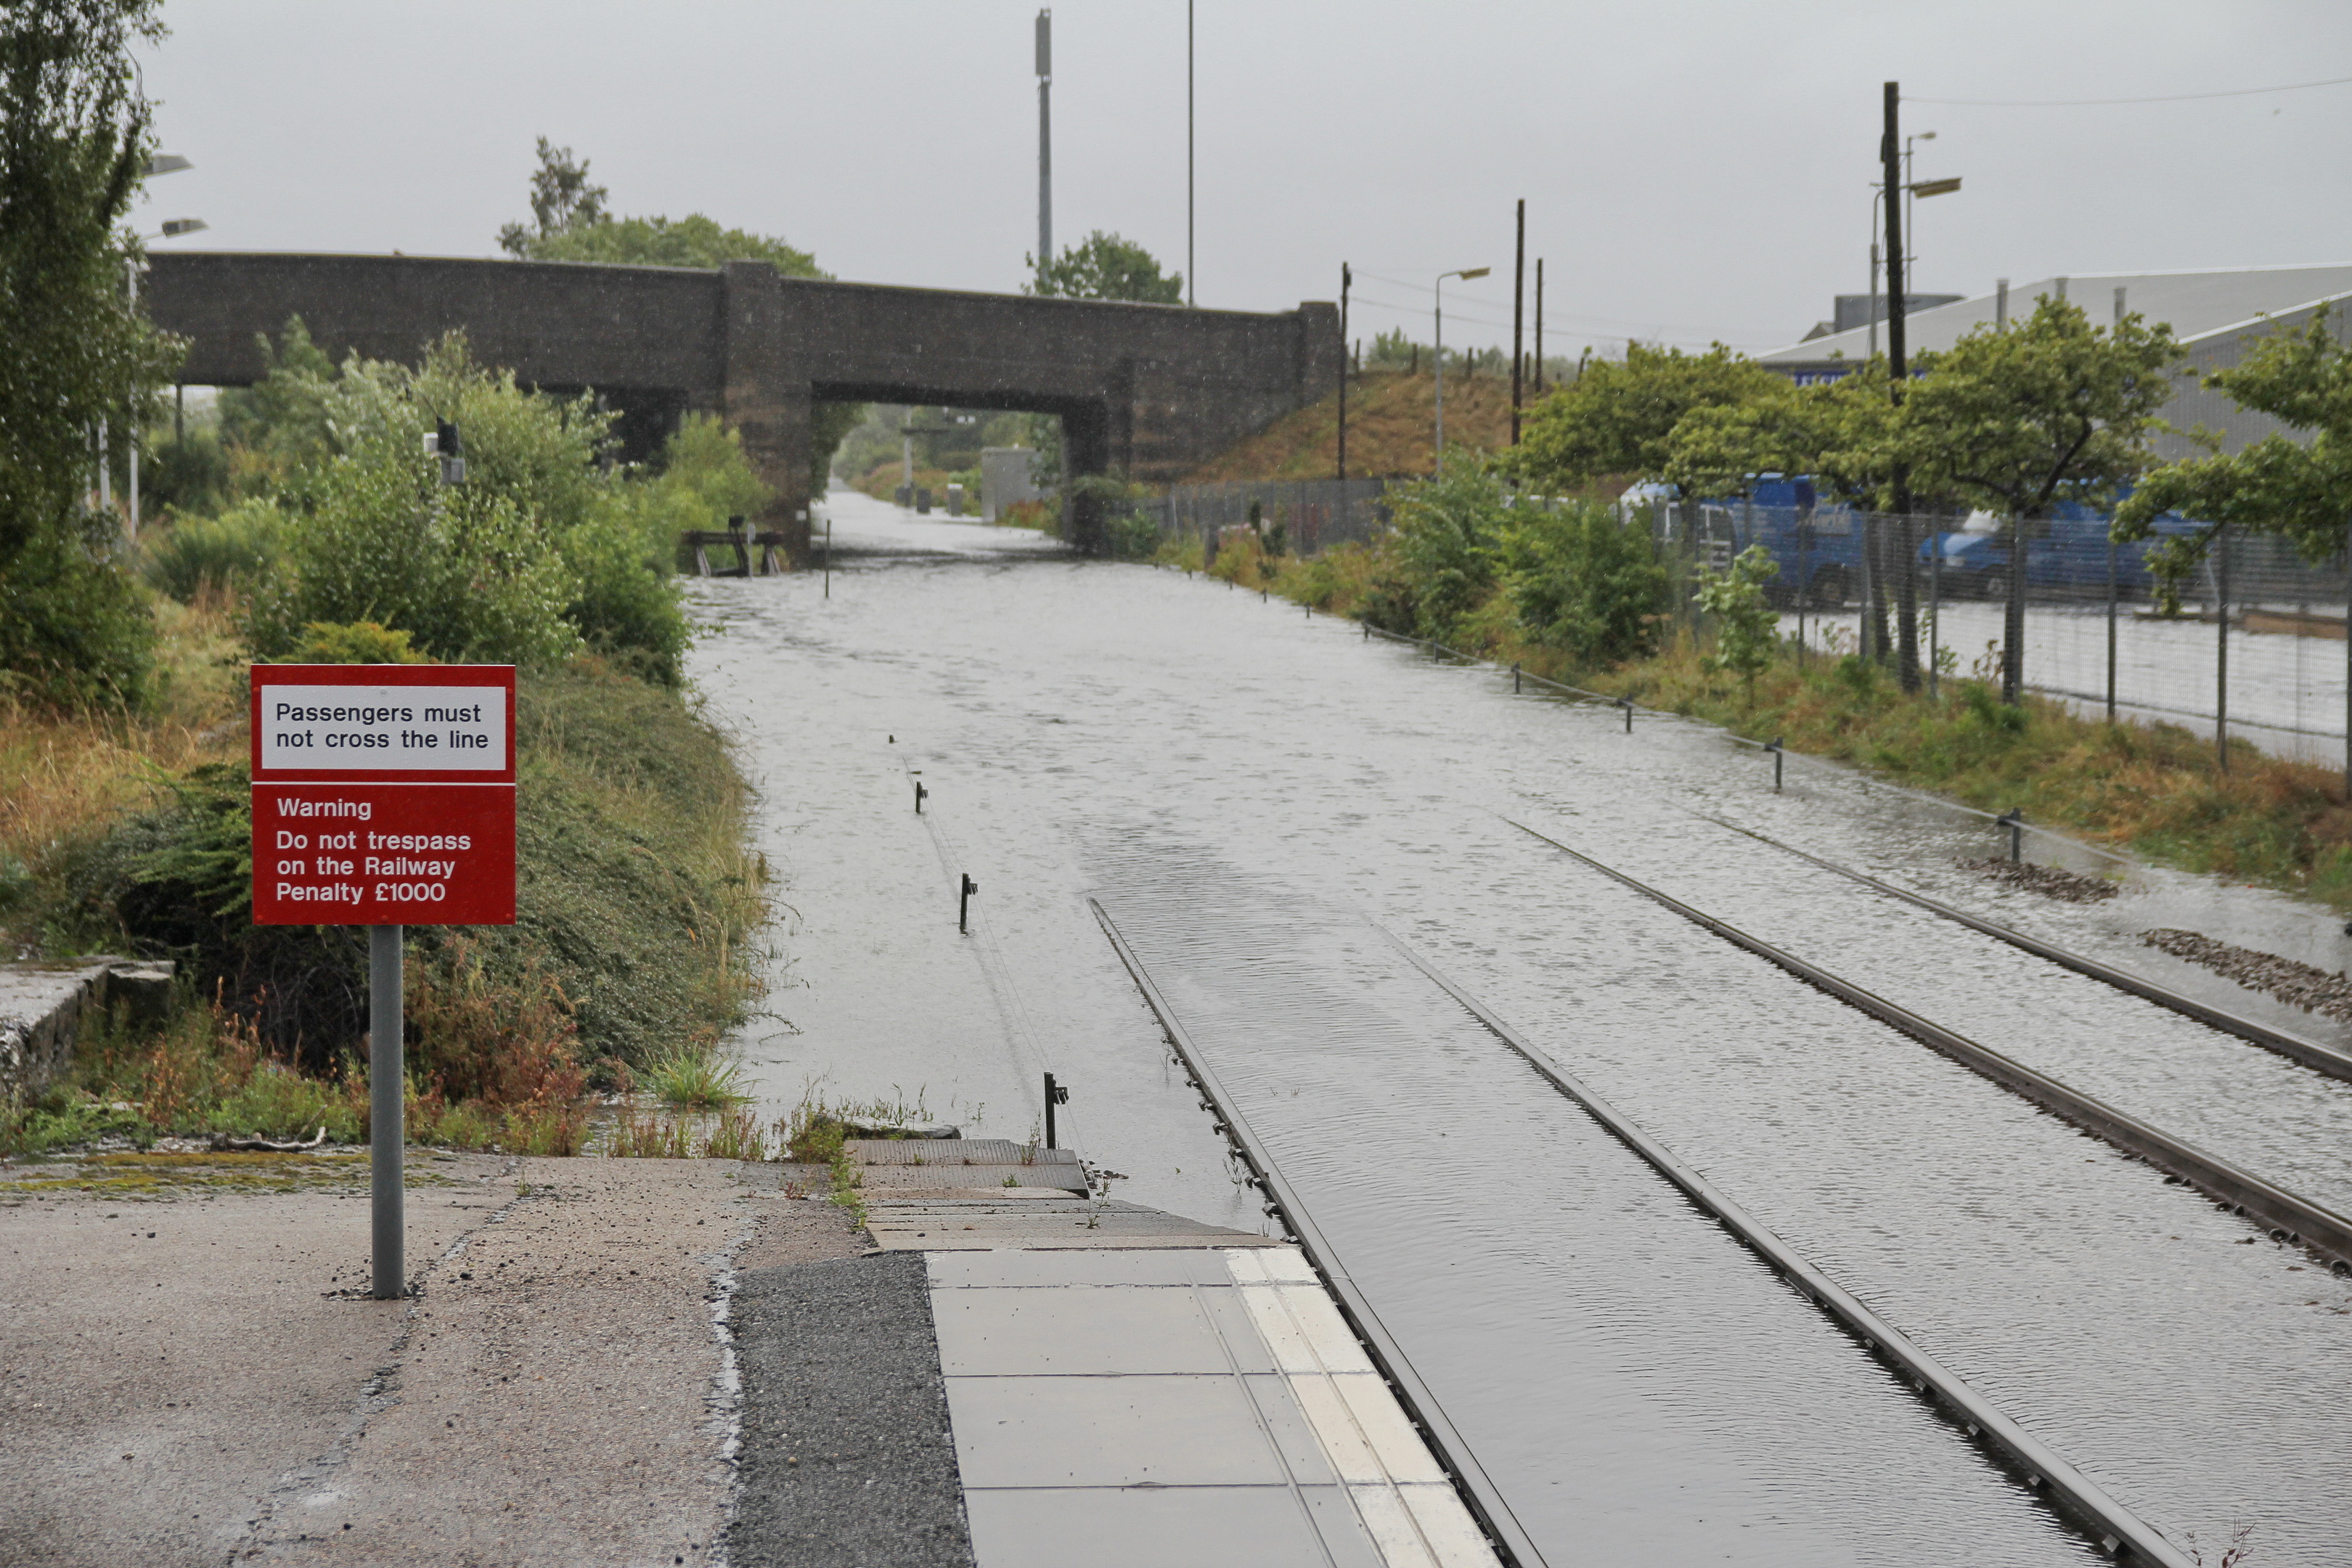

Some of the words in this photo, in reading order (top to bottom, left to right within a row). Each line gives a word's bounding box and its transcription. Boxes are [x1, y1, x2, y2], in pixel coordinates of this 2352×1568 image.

[277, 703, 413, 725] Passengers
[425, 704, 481, 722] must
[277, 729, 314, 748] not
[325, 733, 390, 748] cross
[401, 730, 438, 748] the
[449, 730, 489, 748] line
[277, 798, 372, 820] Warning
[277, 830, 308, 849] Do
[319, 830, 356, 850] not
[367, 830, 471, 854] trespass
[277, 859, 305, 875] on
[317, 856, 354, 875] the
[365, 857, 456, 879] Railway
[277, 882, 364, 905] Penalty
[375, 882, 446, 902] £1000
